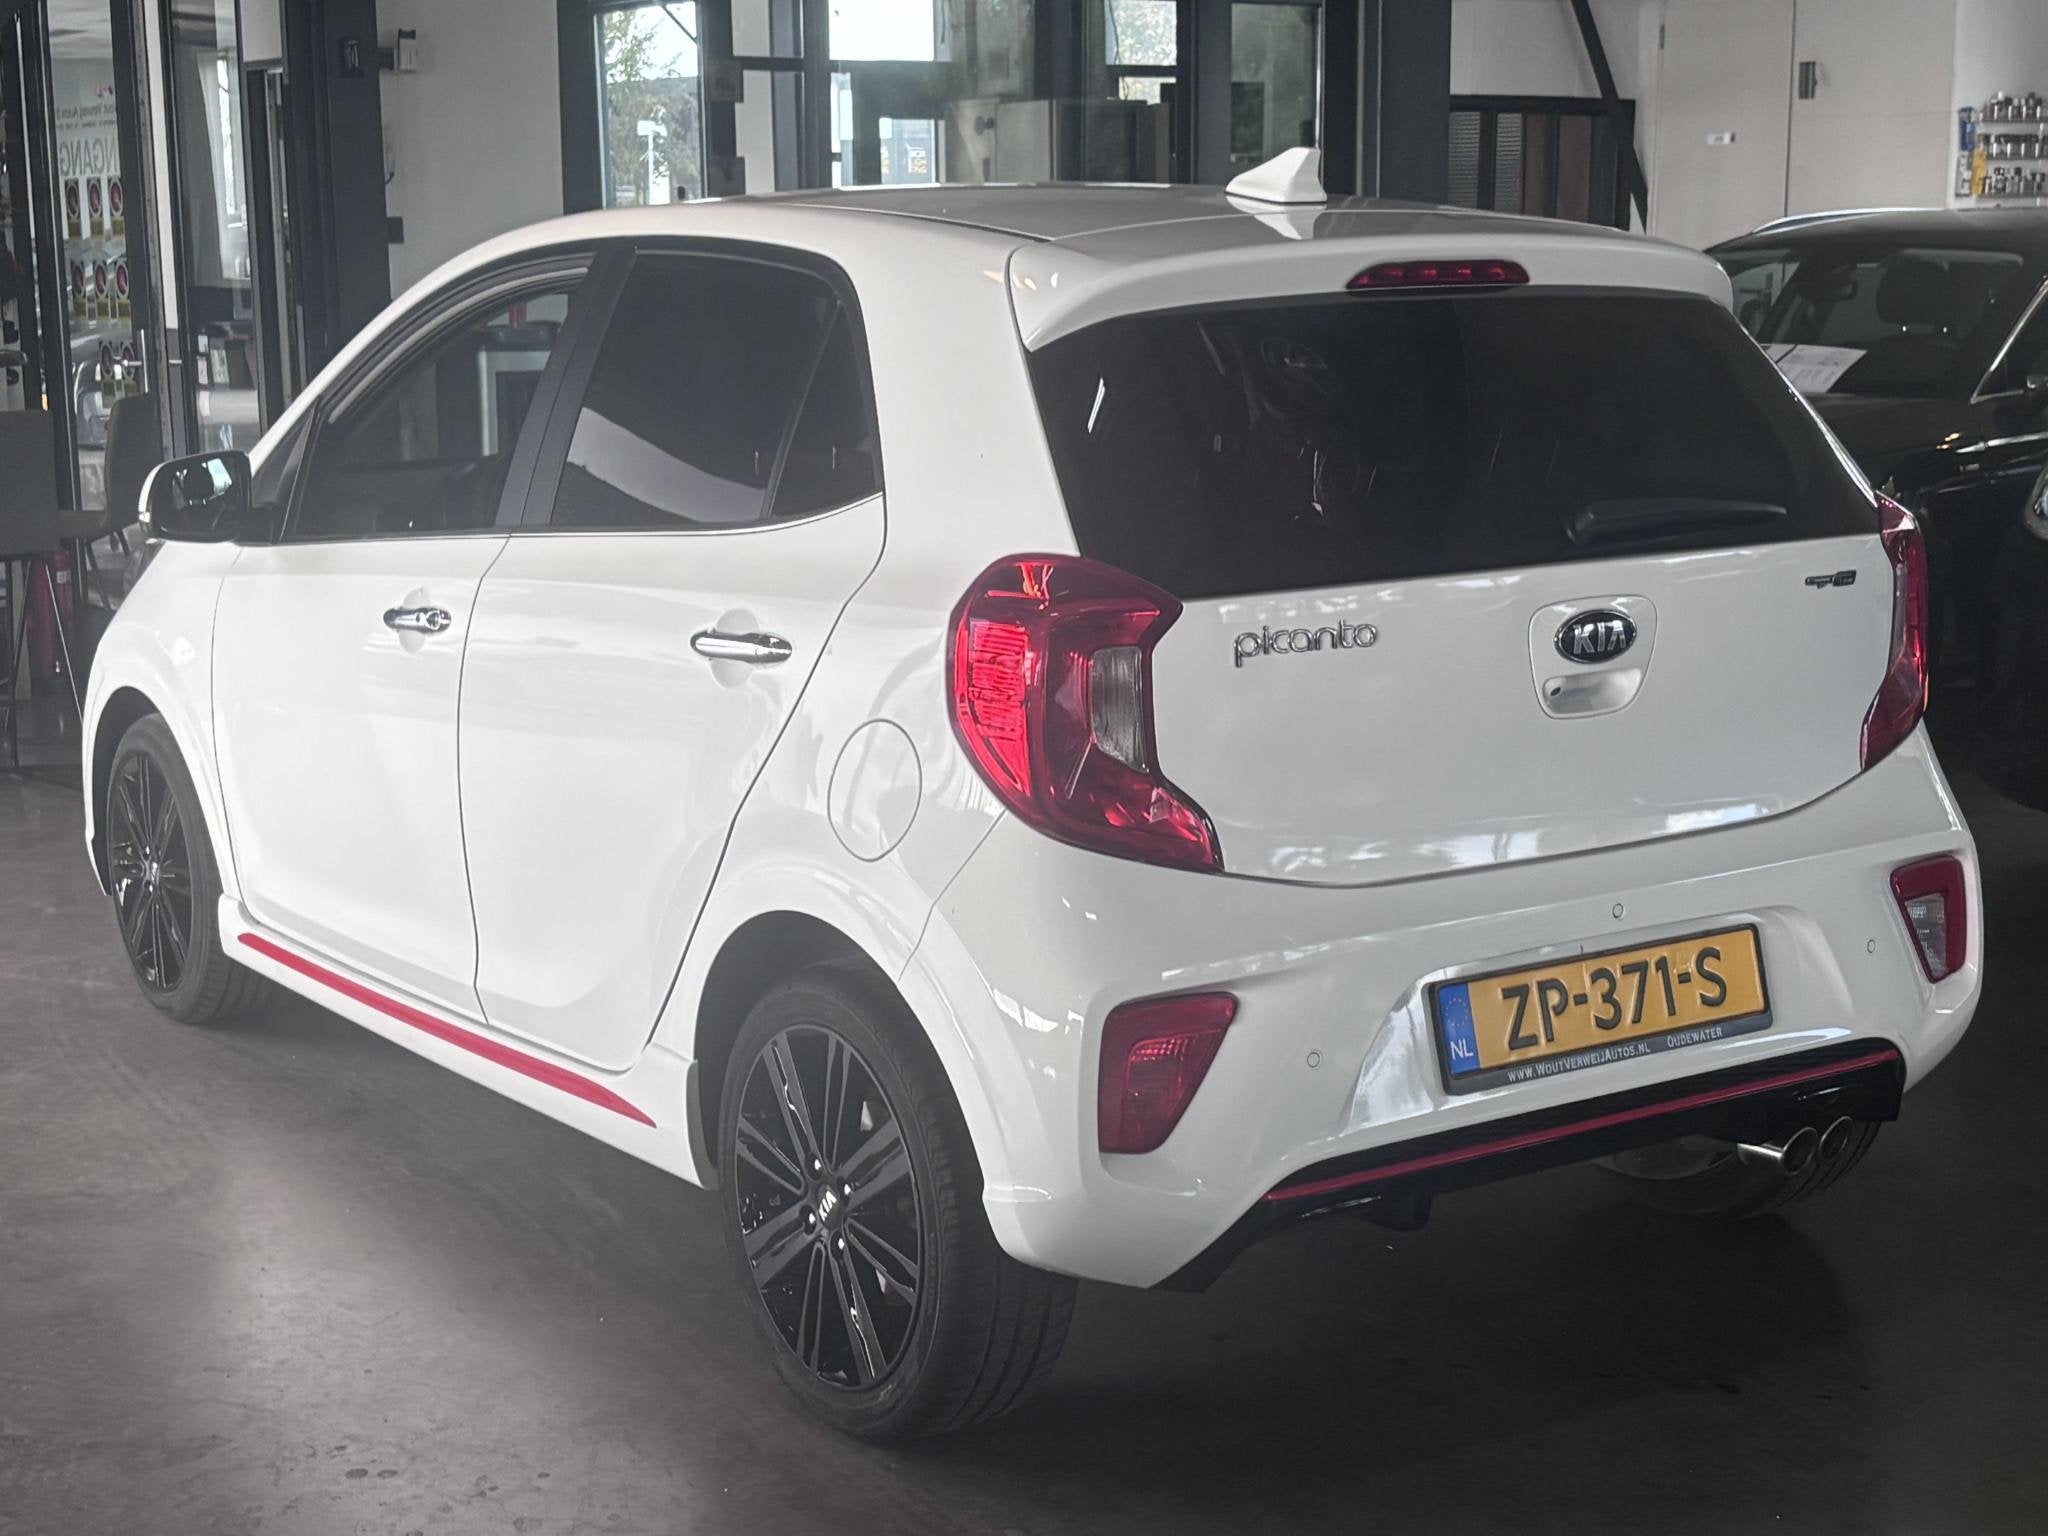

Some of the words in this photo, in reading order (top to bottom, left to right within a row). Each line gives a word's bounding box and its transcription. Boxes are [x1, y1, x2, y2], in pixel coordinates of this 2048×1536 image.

[1234, 619, 1377, 668] picanto
[1573, 620, 1626, 654] KIA
[1501, 946, 1727, 1051] ZP-371-S
[1450, 1038, 1474, 1060] NL
[1666, 1027, 1723, 1048] OUDEWATER
